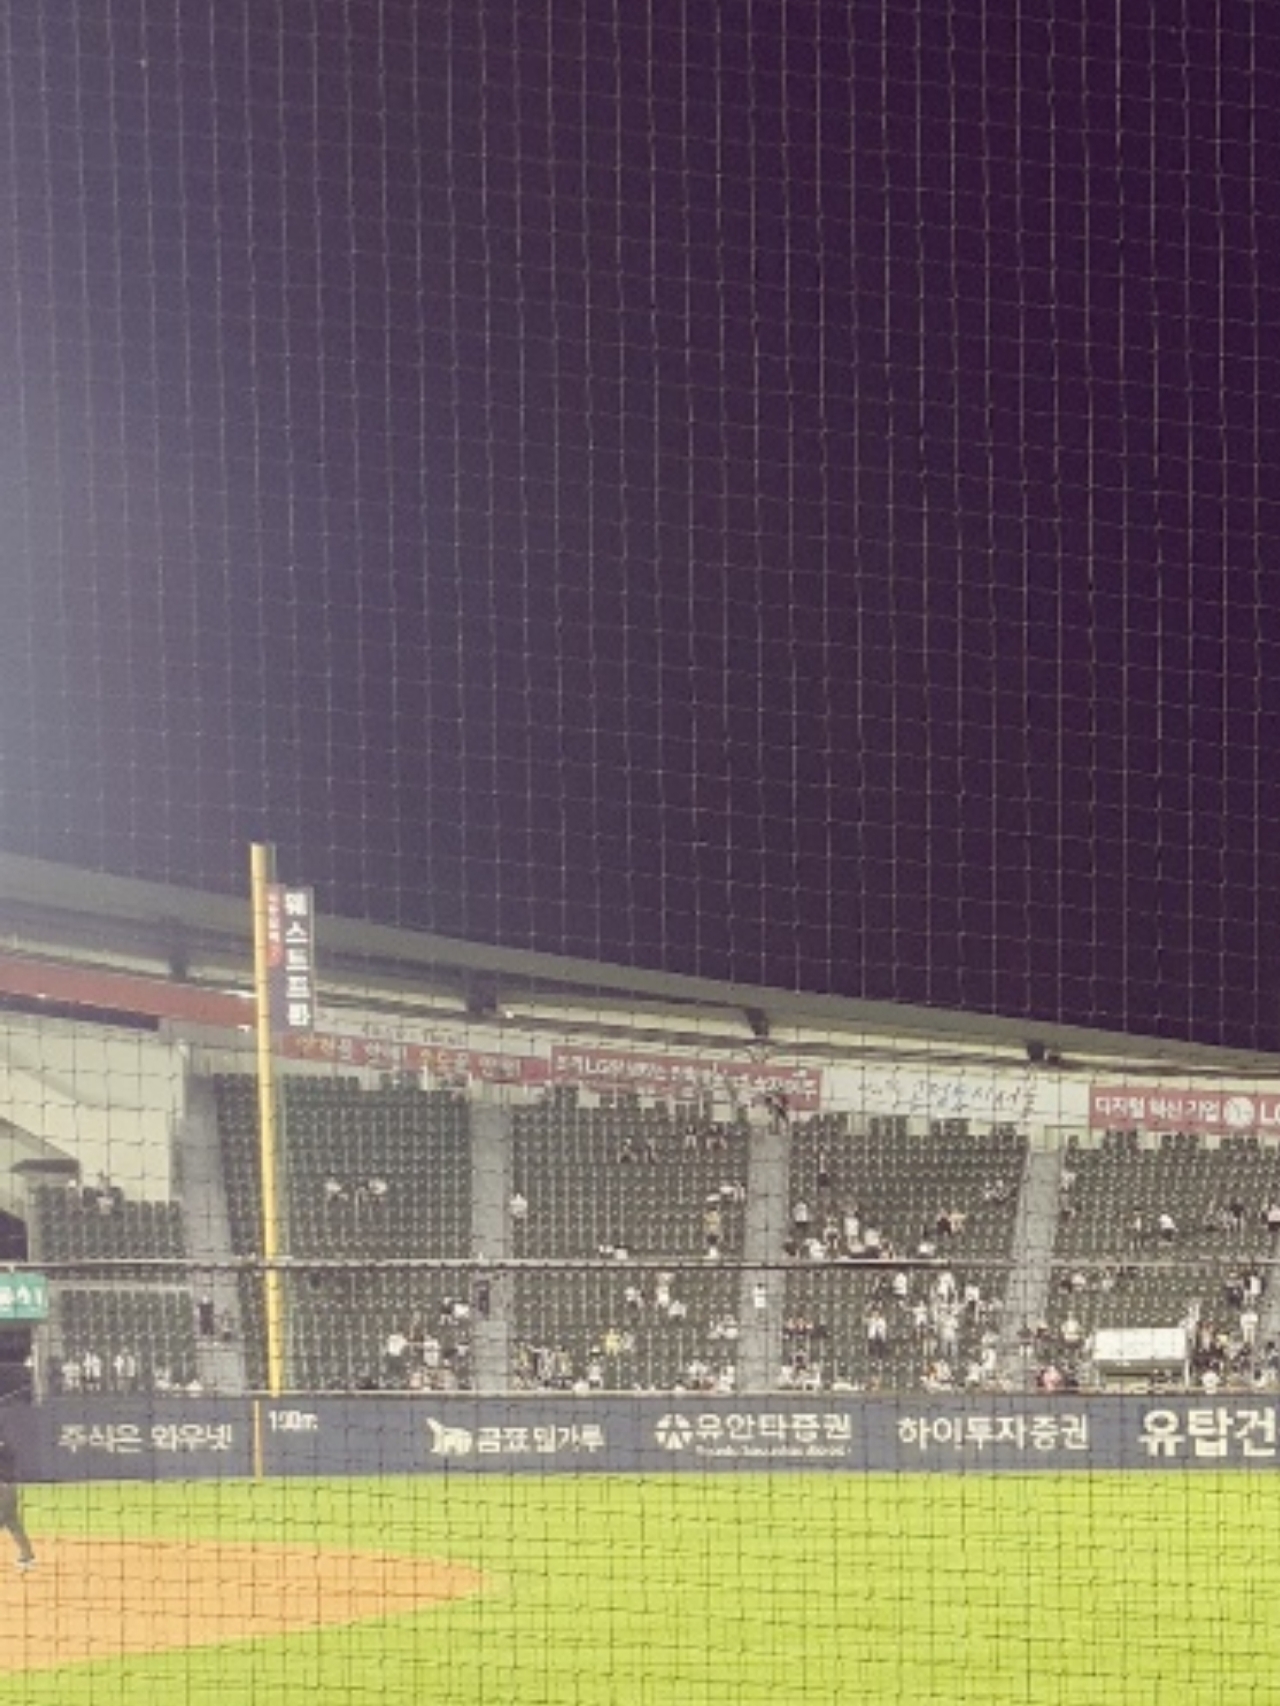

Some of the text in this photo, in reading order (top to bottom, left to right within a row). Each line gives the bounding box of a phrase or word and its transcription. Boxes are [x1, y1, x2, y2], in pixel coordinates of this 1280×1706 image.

[58, 1423, 142, 1453] 주식은
[696, 1413, 852, 1443] 유안타증권
[897, 1414, 1089, 1451] 하이투자증권
